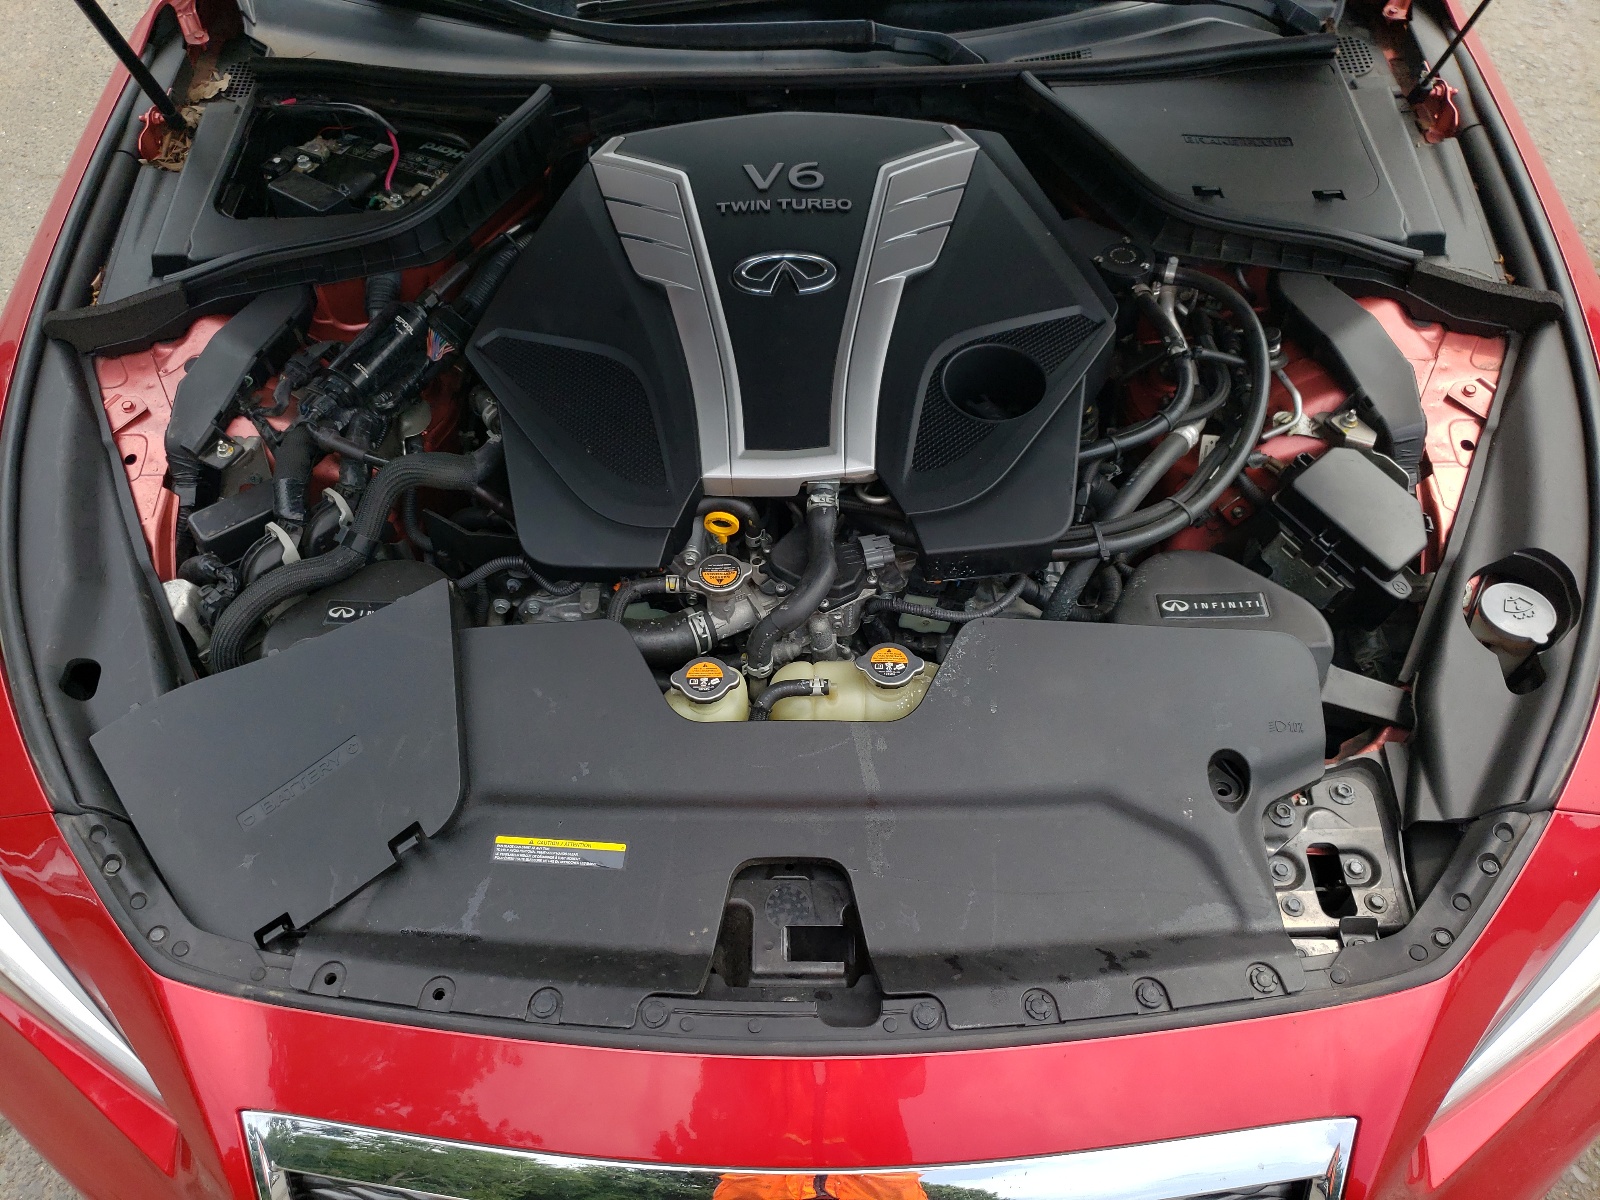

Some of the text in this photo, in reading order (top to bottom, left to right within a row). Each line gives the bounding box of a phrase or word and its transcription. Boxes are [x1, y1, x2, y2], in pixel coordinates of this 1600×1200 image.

[743, 161, 825, 191] V6
[716, 198, 853, 214] TWIN TURBO
[394, 315, 414, 336] SPOOL
[1193, 600, 1260, 610] INFINITI
[261, 751, 341, 816] BATTERY
